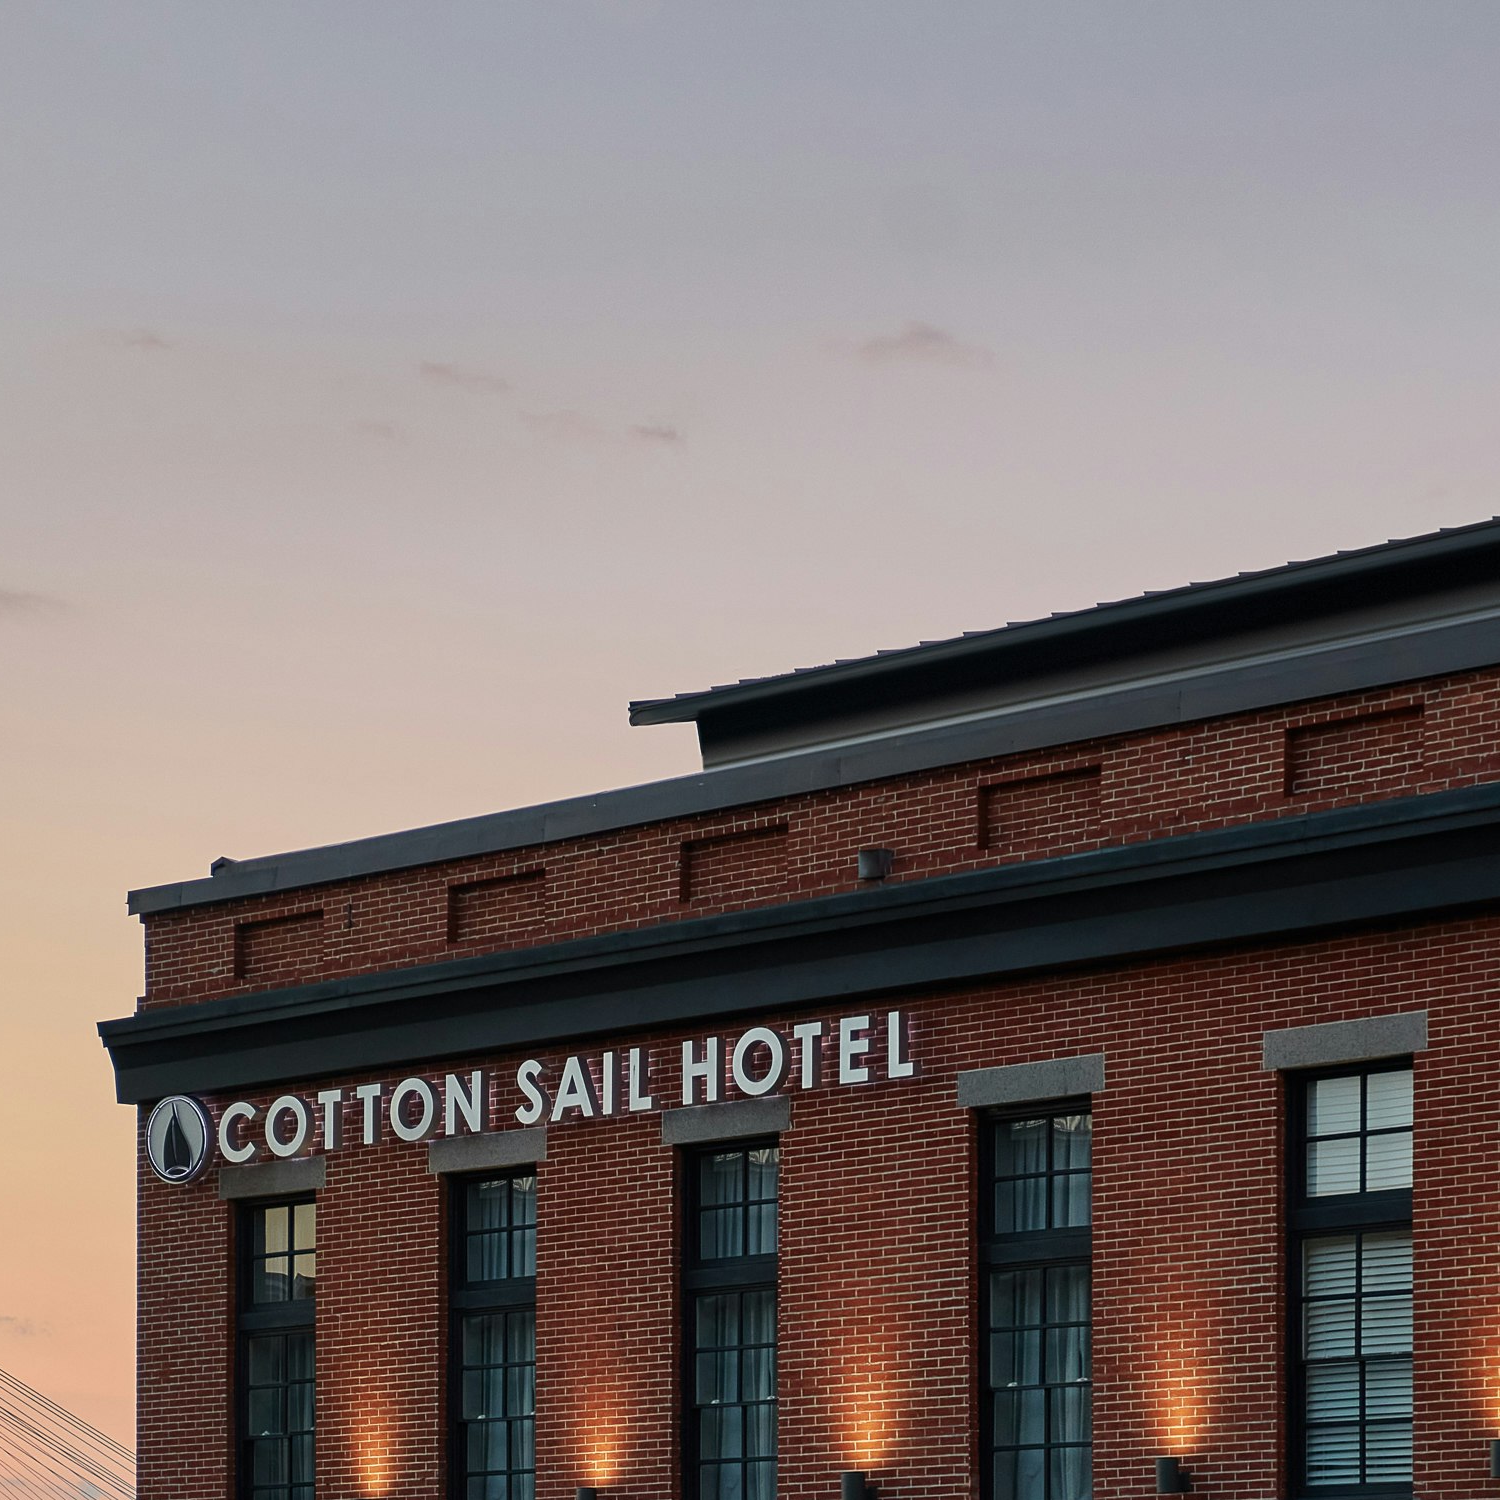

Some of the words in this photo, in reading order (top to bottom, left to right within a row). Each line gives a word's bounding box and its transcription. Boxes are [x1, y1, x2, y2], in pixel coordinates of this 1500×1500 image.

[219, 1071, 483, 1163] COTTON
[515, 1048, 652, 1125] SAIL
[682, 1011, 914, 1105] HOTEL
